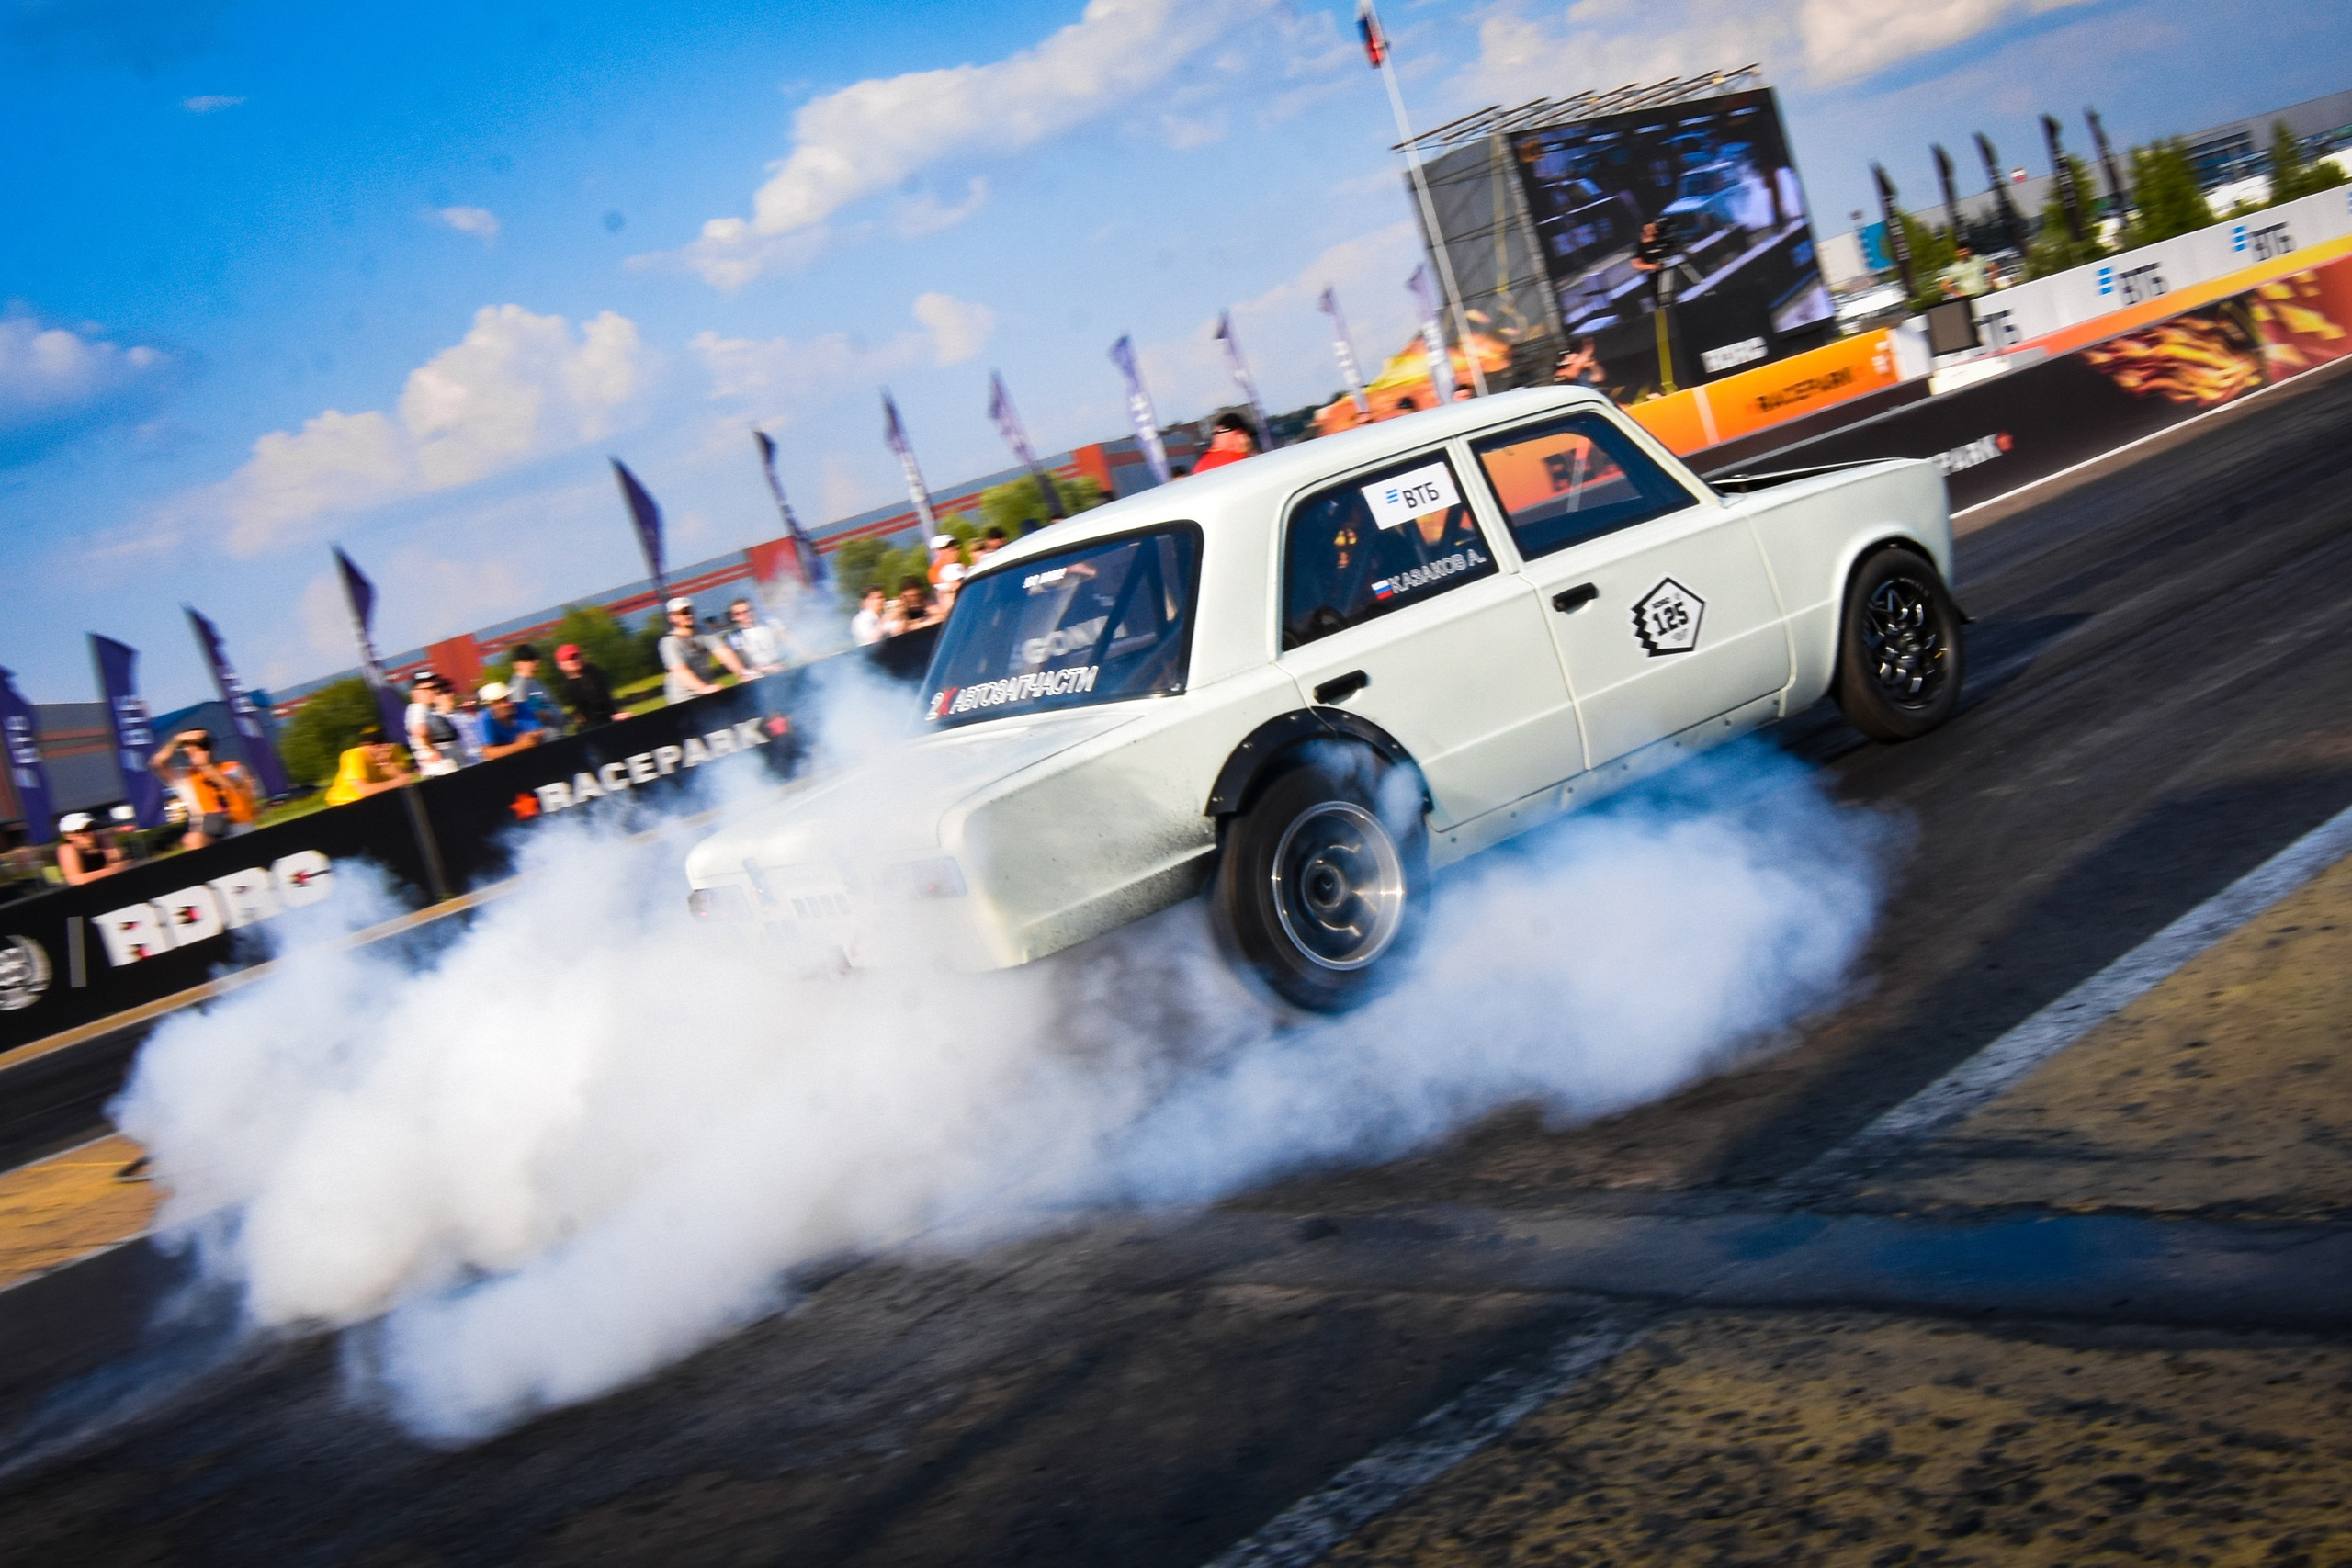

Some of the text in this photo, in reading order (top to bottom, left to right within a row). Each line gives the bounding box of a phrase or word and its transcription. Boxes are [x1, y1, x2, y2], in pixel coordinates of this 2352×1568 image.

[1402, 481, 1440, 509] ВТБ
[1387, 548, 1487, 594] КАЗАКОВ А.
[1653, 601, 1689, 637] 125
[949, 665, 1099, 715] АВТОЗАПЧАСТИ
[533, 716, 770, 813] RACEPARK
[90, 850, 335, 967] RDRC
